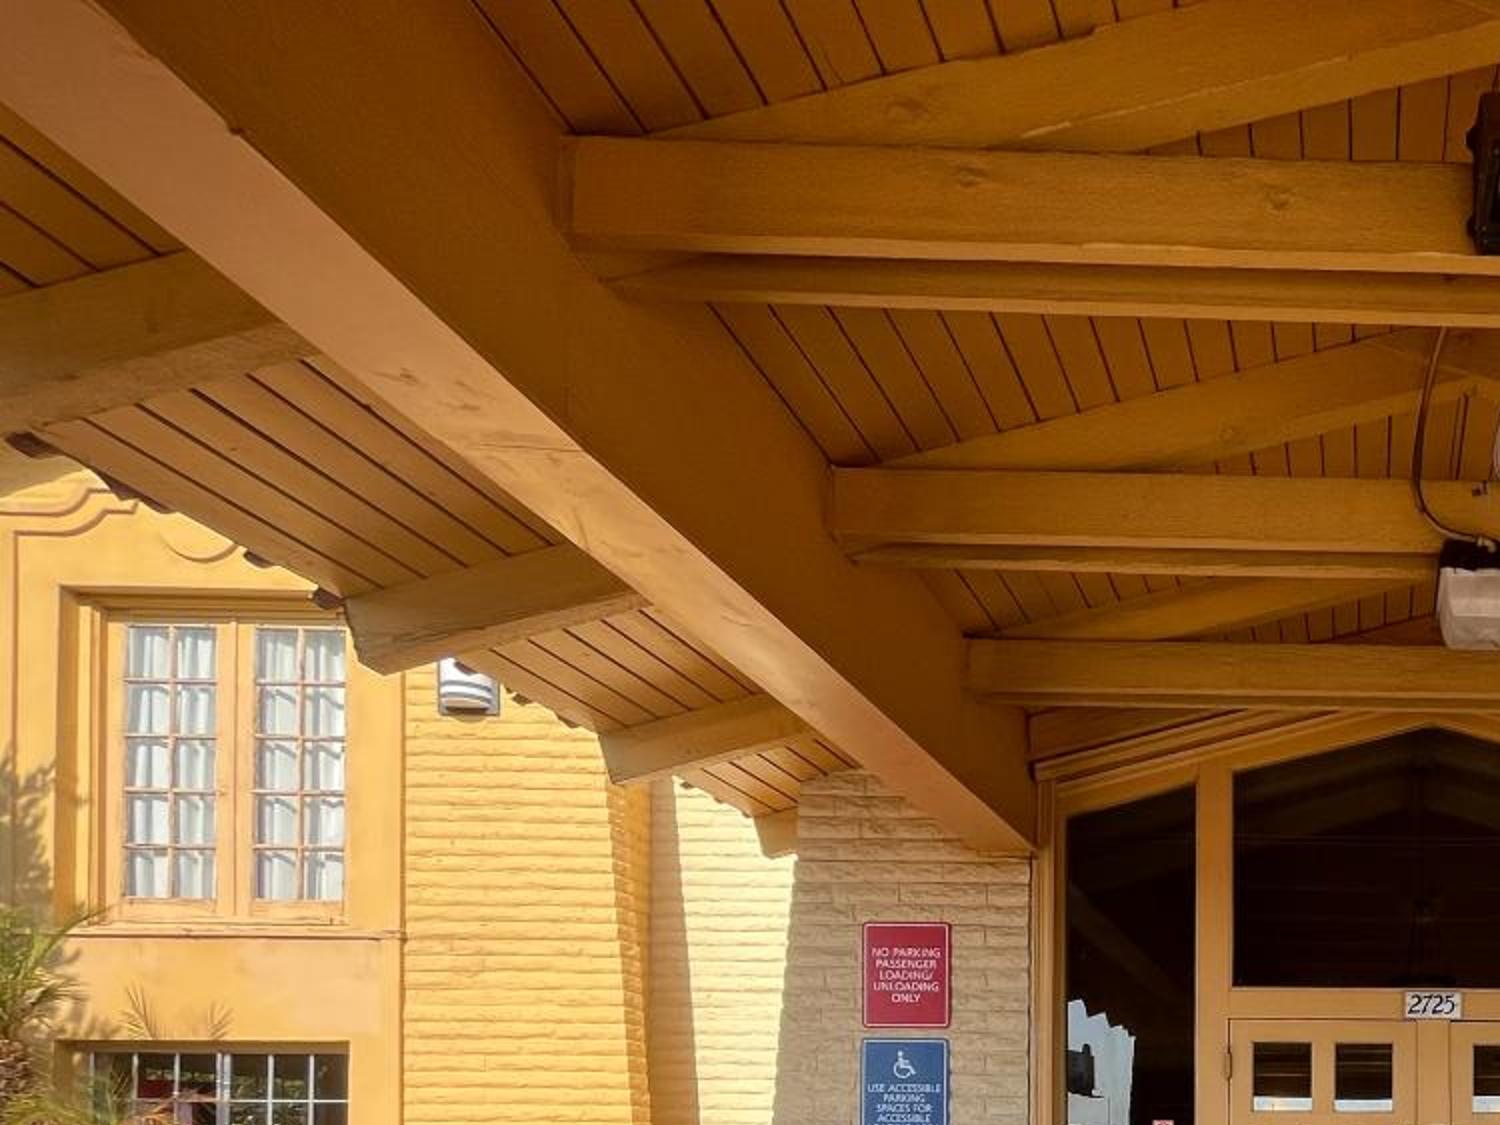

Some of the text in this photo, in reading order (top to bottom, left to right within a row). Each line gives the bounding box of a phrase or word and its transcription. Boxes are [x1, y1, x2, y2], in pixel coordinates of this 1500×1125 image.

[872, 947, 940, 957] NO PARKING
[875, 959, 937, 969] PASSENGER
[879, 970, 933, 980] LOADING/
[873, 982, 940, 992] UNLOADING
[891, 993, 921, 1003] ONLY
[1407, 994, 1455, 1014] 2725
[867, 1083, 941, 1093] USE ACCESSIBLE
[883, 1094, 925, 1103] PARKING
[876, 1104, 932, 1113] SPACES FOR
[877, 1114, 931, 1123] ACCESSIBLE
